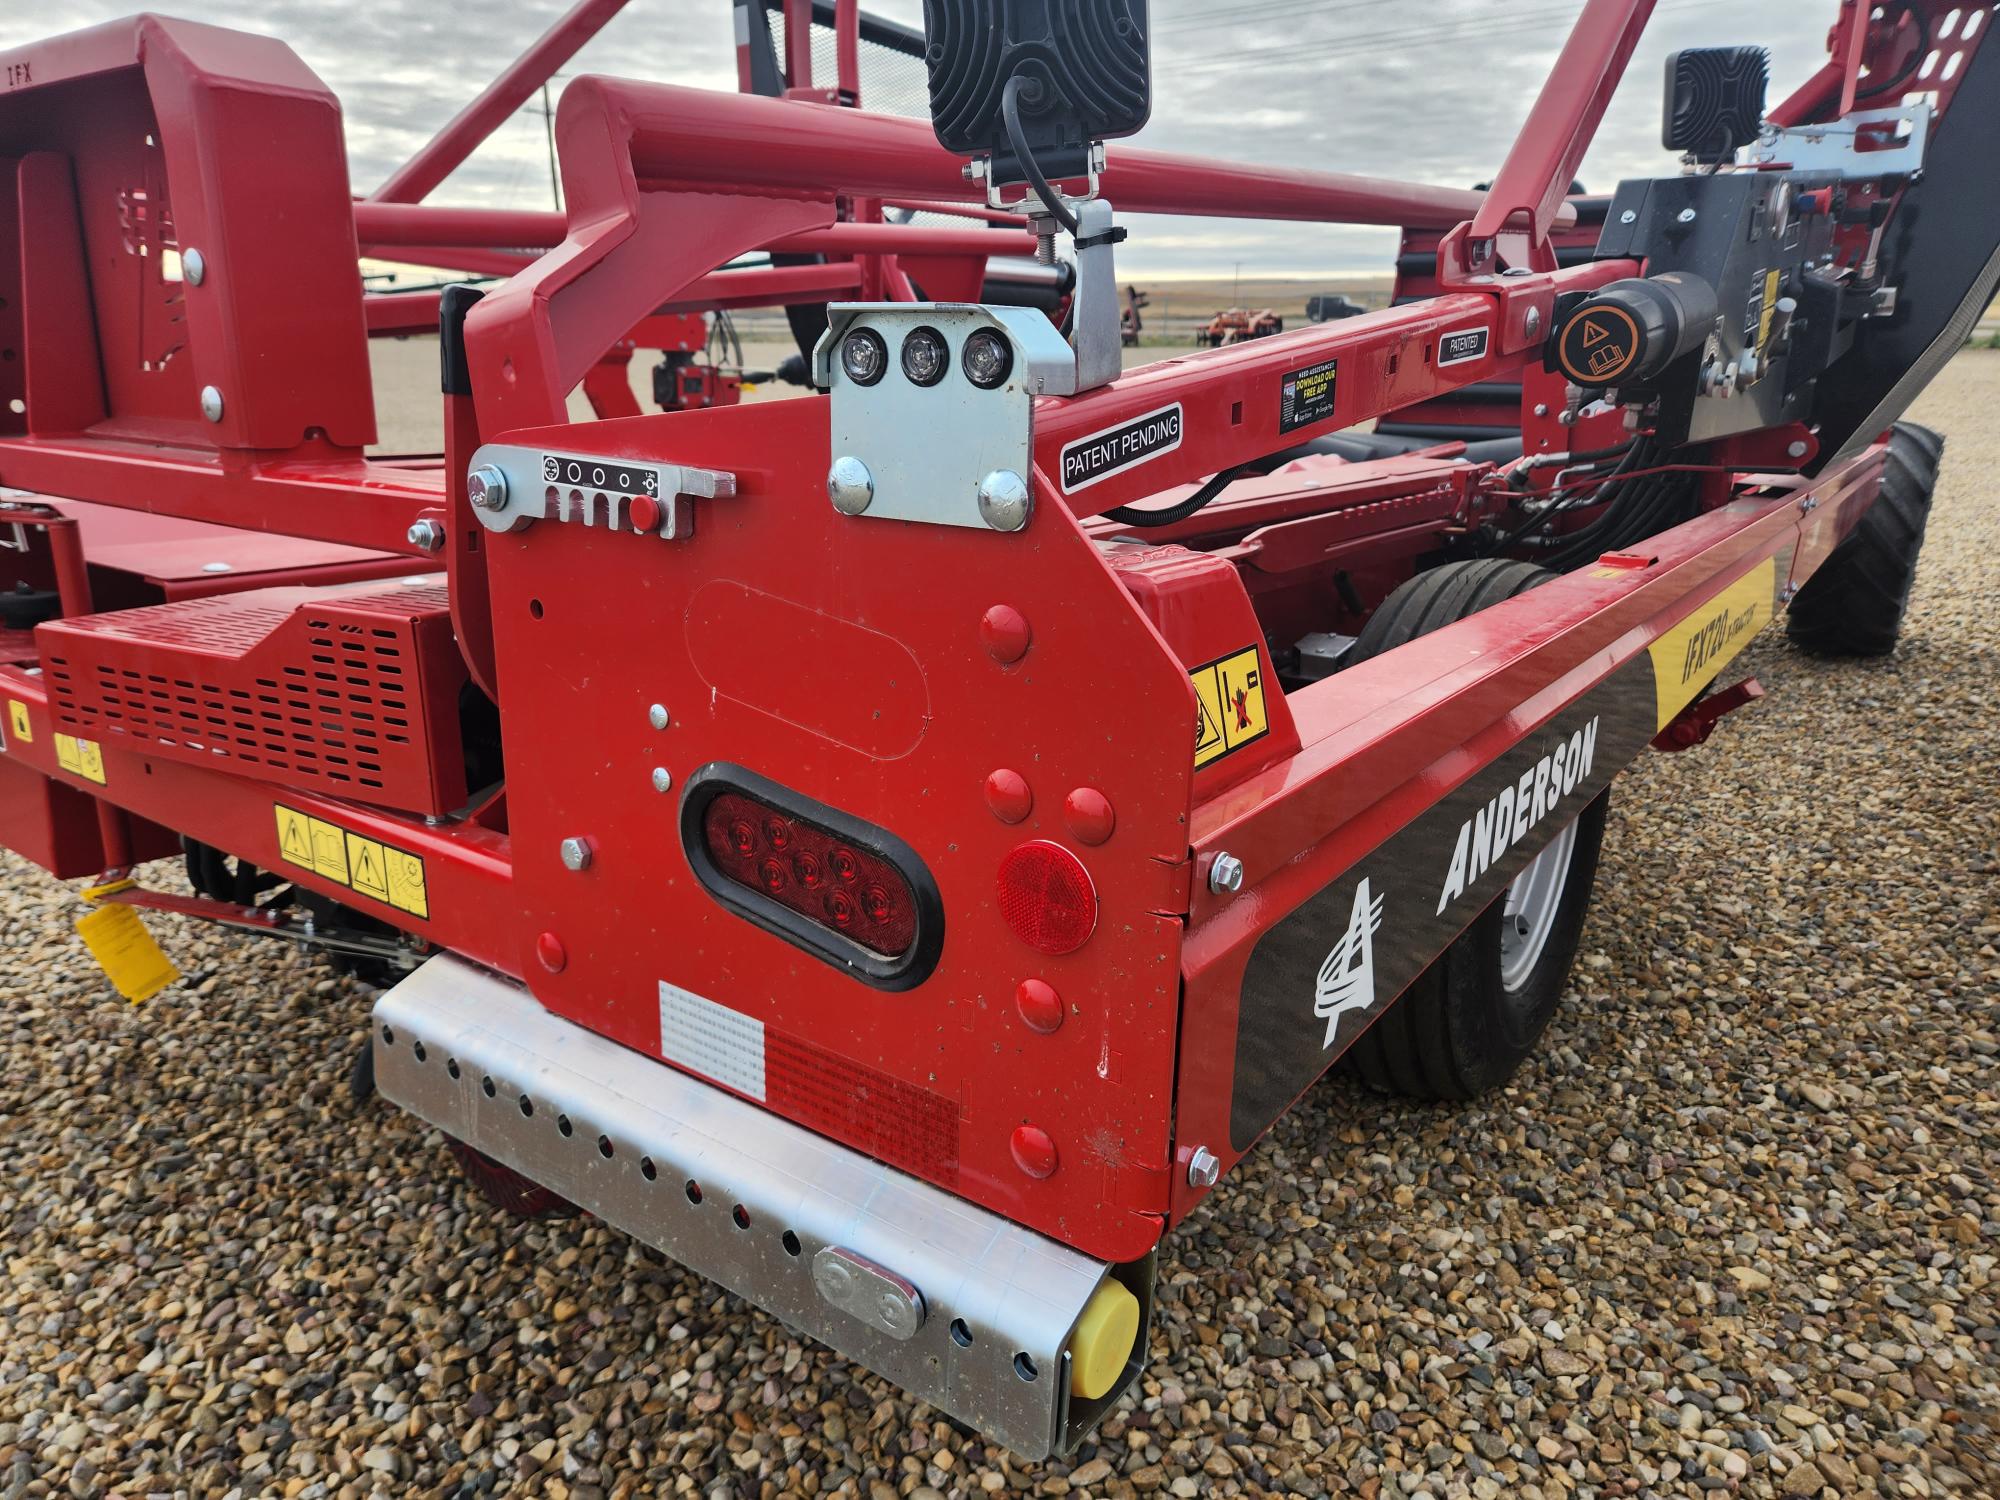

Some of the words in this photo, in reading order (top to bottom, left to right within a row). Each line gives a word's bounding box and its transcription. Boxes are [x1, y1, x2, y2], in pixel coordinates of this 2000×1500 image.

[8, 61, 32, 86] IFX
[1450, 335, 1478, 352] PATENTED
[1296, 373, 1324, 390] DOWNLOAD
[1325, 370, 1335, 381] OUR
[1304, 386, 1316, 399] FREE
[1317, 383, 1327, 394] APP
[1066, 439, 1118, 478] PATENT
[1122, 416, 1178, 455] PENDING
[1682, 608, 1728, 685] IFX720
[1436, 715, 1598, 916] ANDERSON
